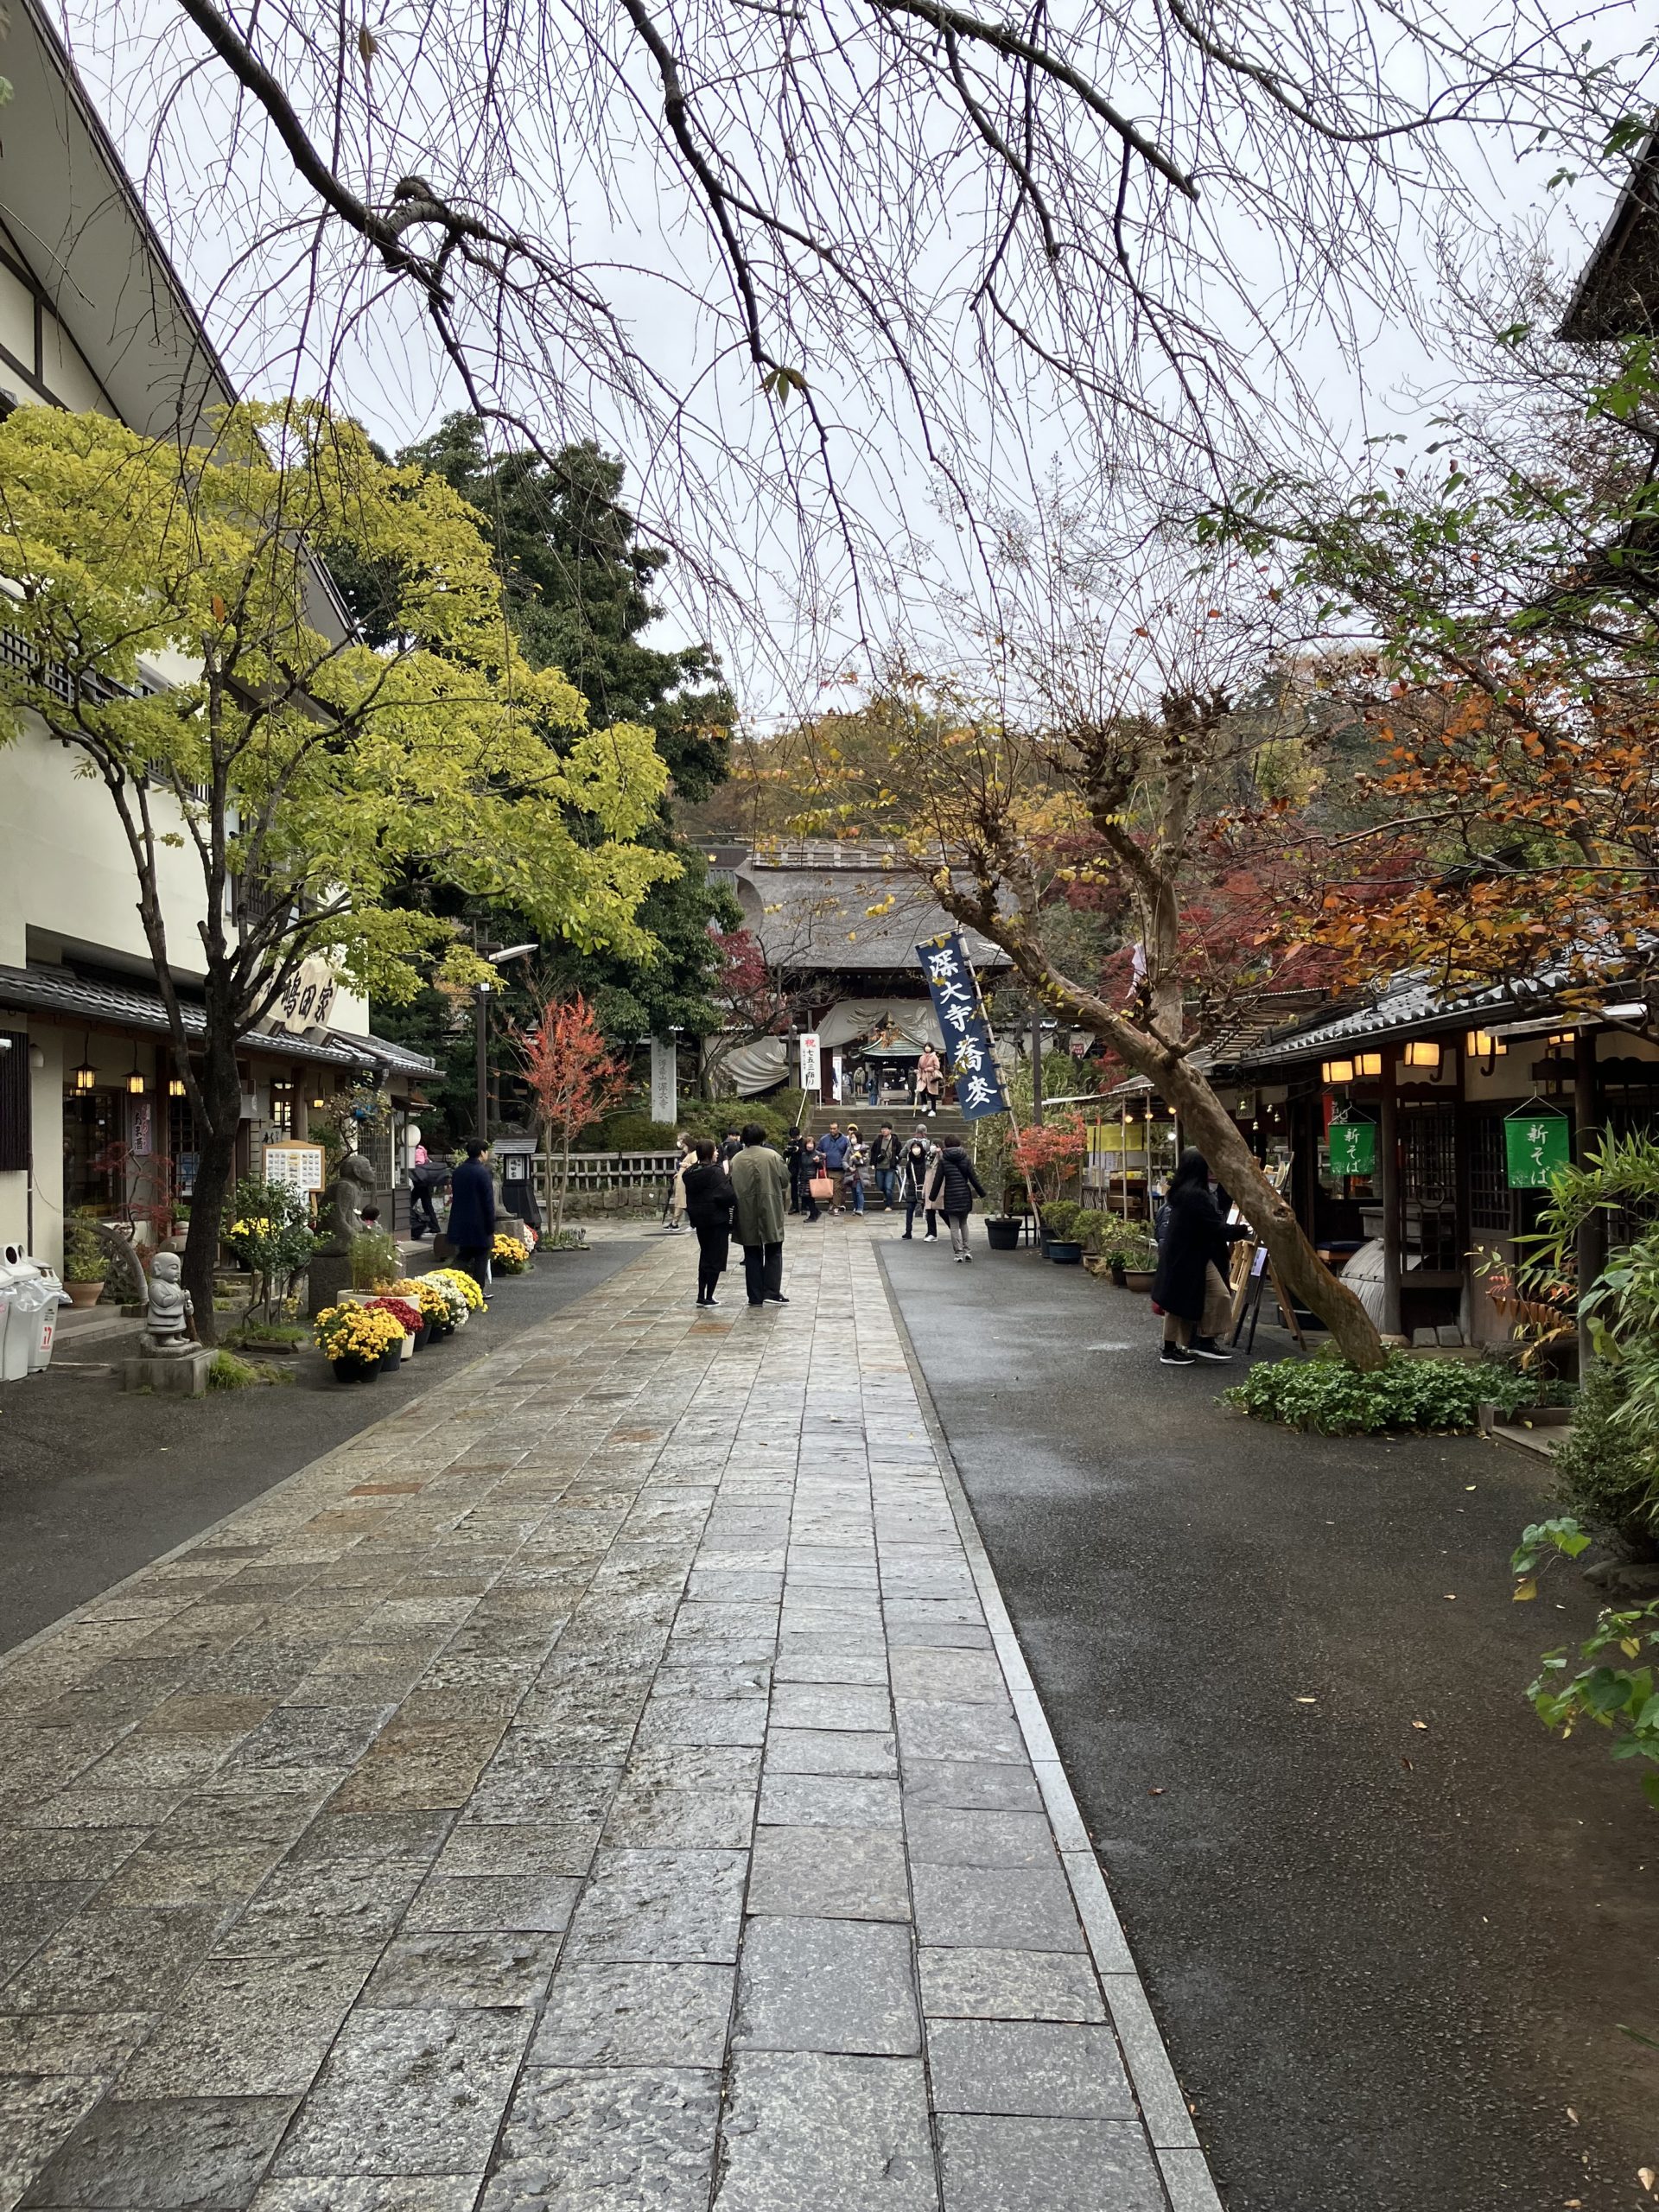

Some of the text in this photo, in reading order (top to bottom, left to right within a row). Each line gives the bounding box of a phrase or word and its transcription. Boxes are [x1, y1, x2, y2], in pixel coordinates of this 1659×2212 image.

[804, 1039, 817, 1047] 祝
[1344, 1128, 1361, 1173] 新そば
[1527, 1123, 1552, 1186] 新そば
